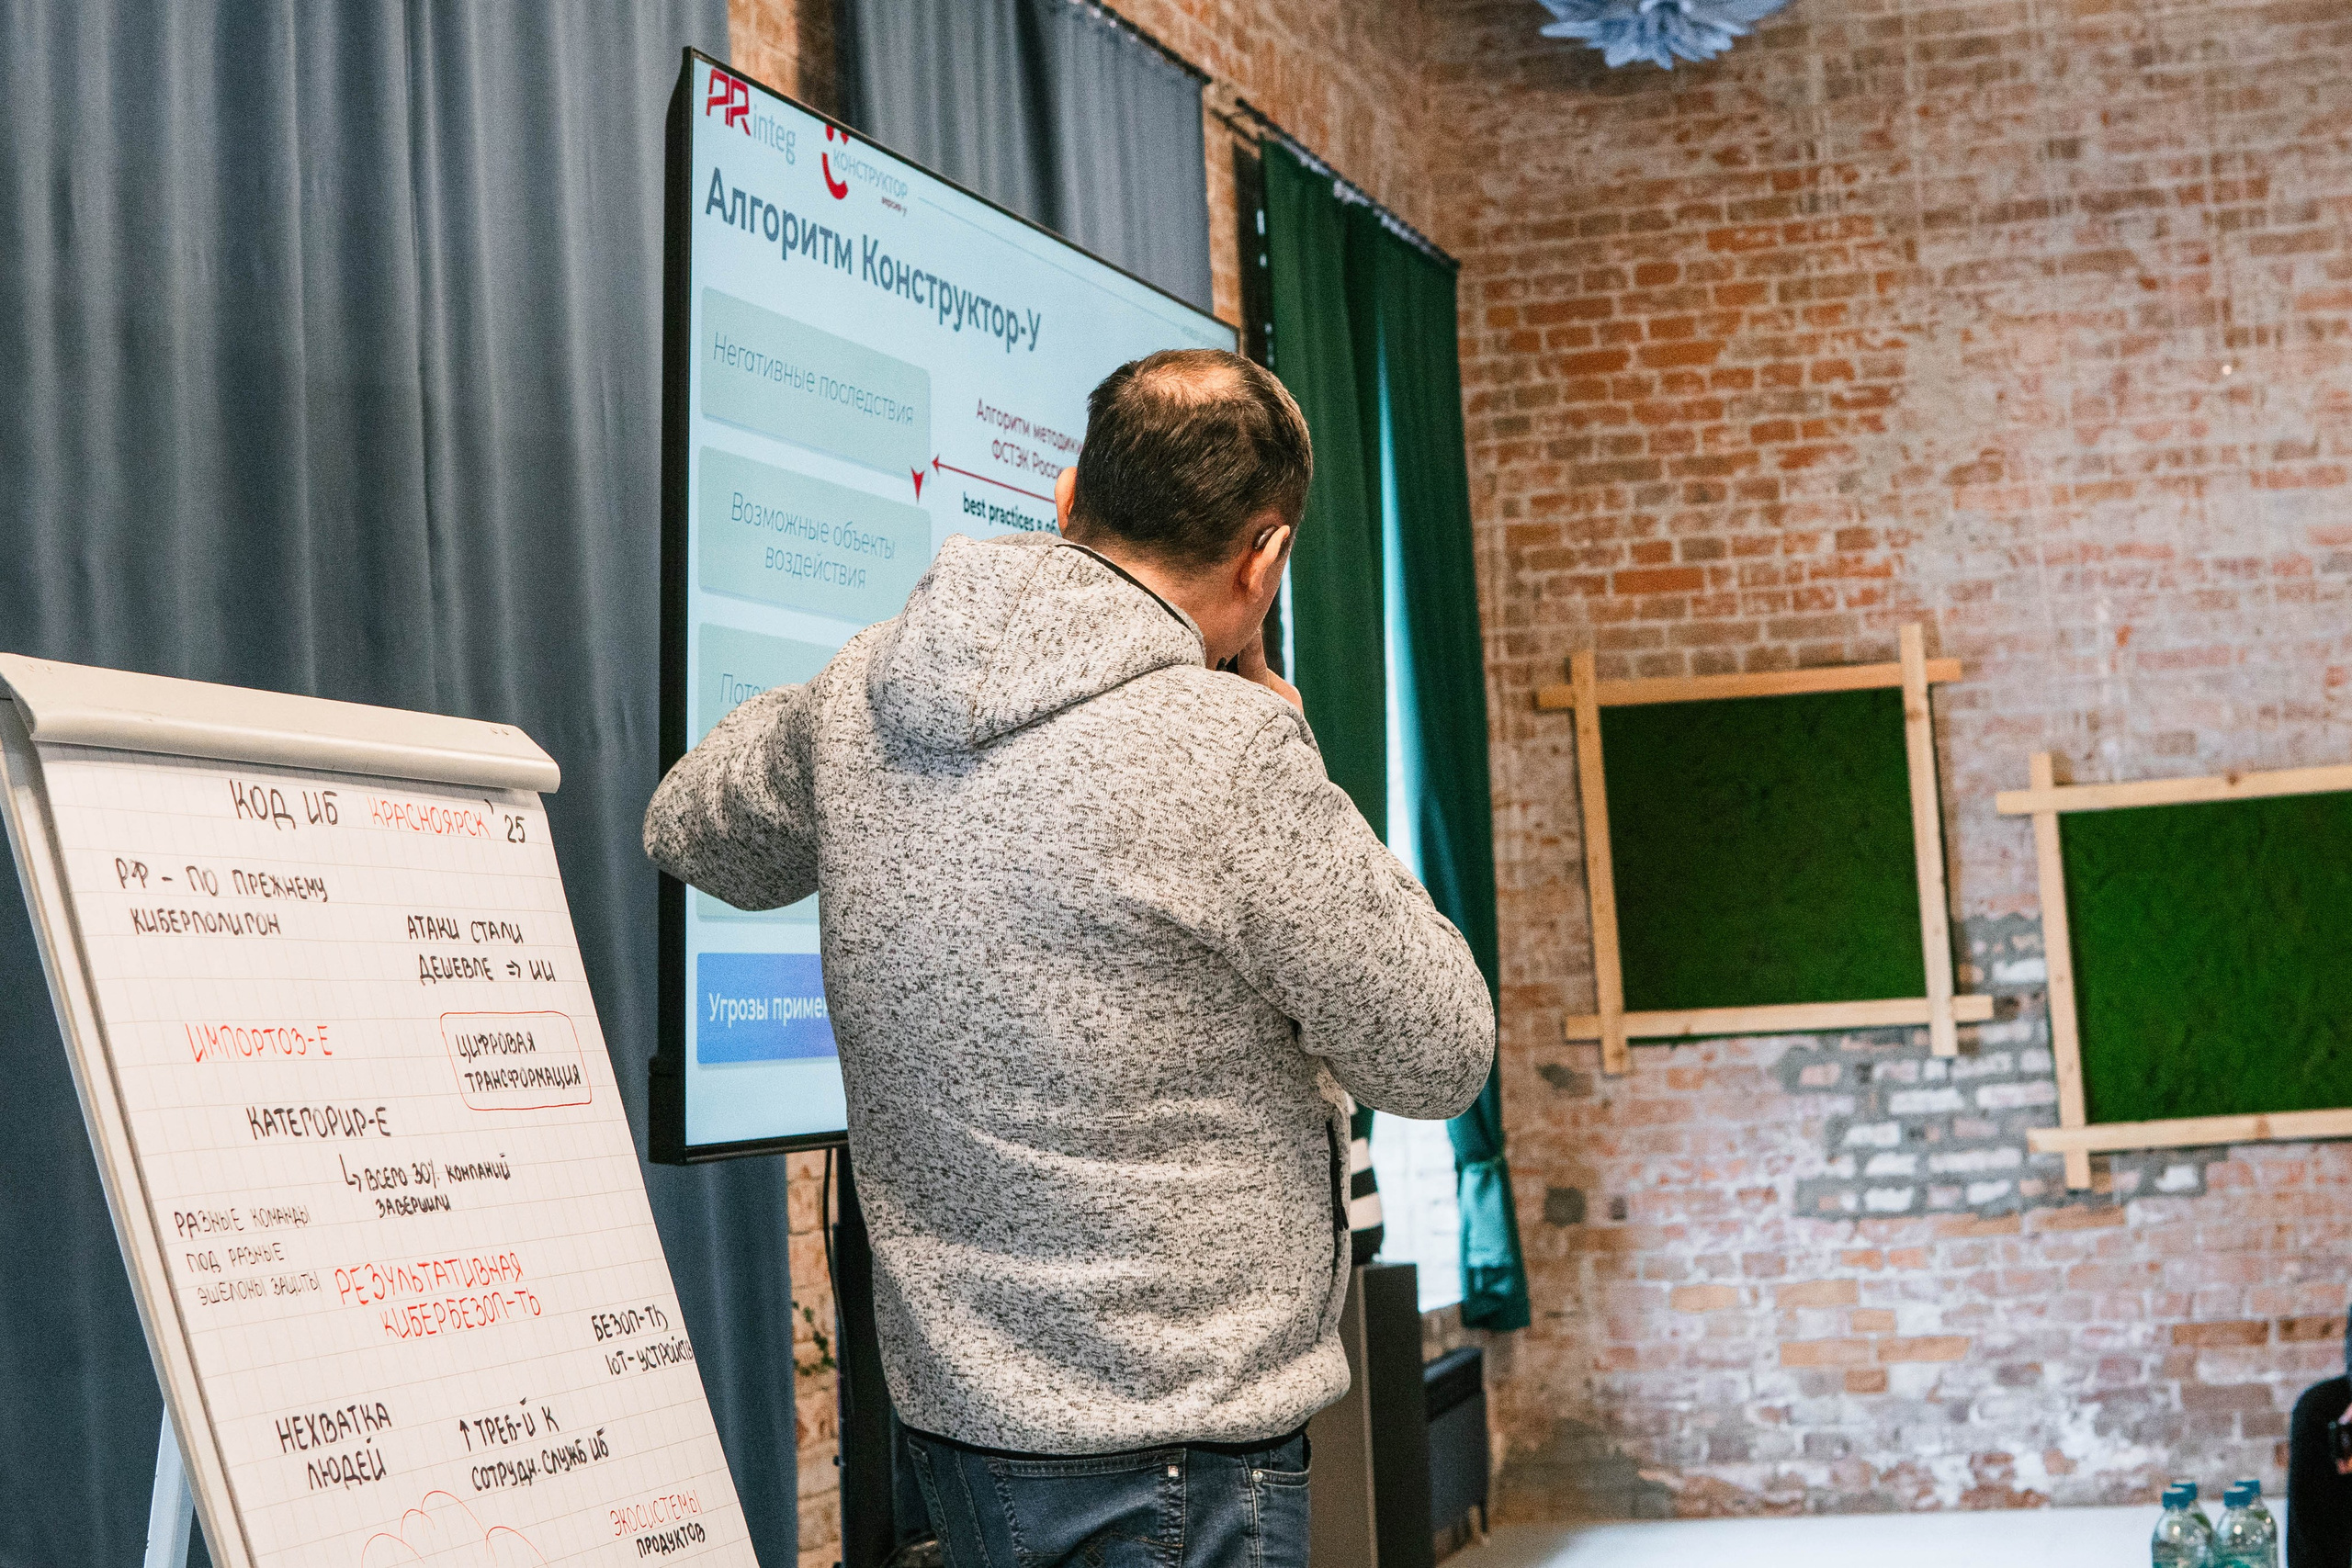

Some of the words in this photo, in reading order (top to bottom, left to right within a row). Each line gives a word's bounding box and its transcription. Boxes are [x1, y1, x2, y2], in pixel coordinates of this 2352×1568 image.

[706, 166, 853, 276] Алгоритм
[863, 233, 1042, 353] Конструктор-У
[714, 332, 815, 393] Негативные
[820, 376, 914, 425] последствия
[977, 399, 1030, 434] Алгоритм
[991, 439, 1029, 471] ФСТЭК
[731, 491, 829, 543] Возможные
[832, 521, 895, 559] объекты
[963, 491, 986, 519] best
[989, 502, 1035, 531] practices
[765, 547, 865, 590] воздействия
[230, 779, 297, 830] КОД
[303, 790, 338, 825] ИБ
[368, 796, 491, 840] КРАСНОЯРСК
[116, 858, 148, 888] РФ
[186, 865, 219, 897] ПО
[232, 869, 328, 903] ПРЕЖНЕМУ
[130, 908, 281, 936] КИБЕРПОЛИГОН
[407, 915, 460, 940] АТАКИ
[470, 920, 524, 944] СТАЛИ
[419, 953, 494, 987] ДЕШЕВЛЕ
[528, 959, 556, 982] ИИ
[708, 992, 768, 1029] Угрозы
[185, 1022, 333, 1063] ИМПОРТОЗ-Е
[456, 1031, 536, 1064] ЦИФРОВАЯ
[464, 1063, 582, 1092] ТРАНСФОРМАЦИЯ
[245, 1105, 391, 1140] КАТЕГОРИР-Е
[365, 1167, 408, 1191] ВСЕГО
[445, 1152, 511, 1184] КОМПАНИЙ
[174, 1208, 244, 1238] РАЗНЫЕ
[250, 1205, 312, 1229] КОМАНДЫ
[375, 1193, 451, 1219] ЗАВЕРШИЛИ
[186, 1250, 221, 1273] ПОД
[228, 1242, 285, 1268] РАЗНЫЕ
[197, 1279, 268, 1306] ЭШЕЛОНЫ
[270, 1271, 323, 1297] ЗАЩИТЫ
[334, 1249, 524, 1305] РЕЗУЛЬТАТИВНАЯ
[379, 1287, 541, 1338] КИБЕРБЕЗОП-ТЬ
[276, 1402, 392, 1453] НЕХВАТКА
[541, 1406, 560, 1432] К
[307, 1437, 387, 1490] ЛЮДЕЙ
[541, 1438, 587, 1474] СЛУЖБ
[588, 1427, 609, 1461] ИБ
[610, 1489, 703, 1537] ЭКОСИСТЕМЫ
[636, 1522, 706, 1558] ПРОДУКТОВ
